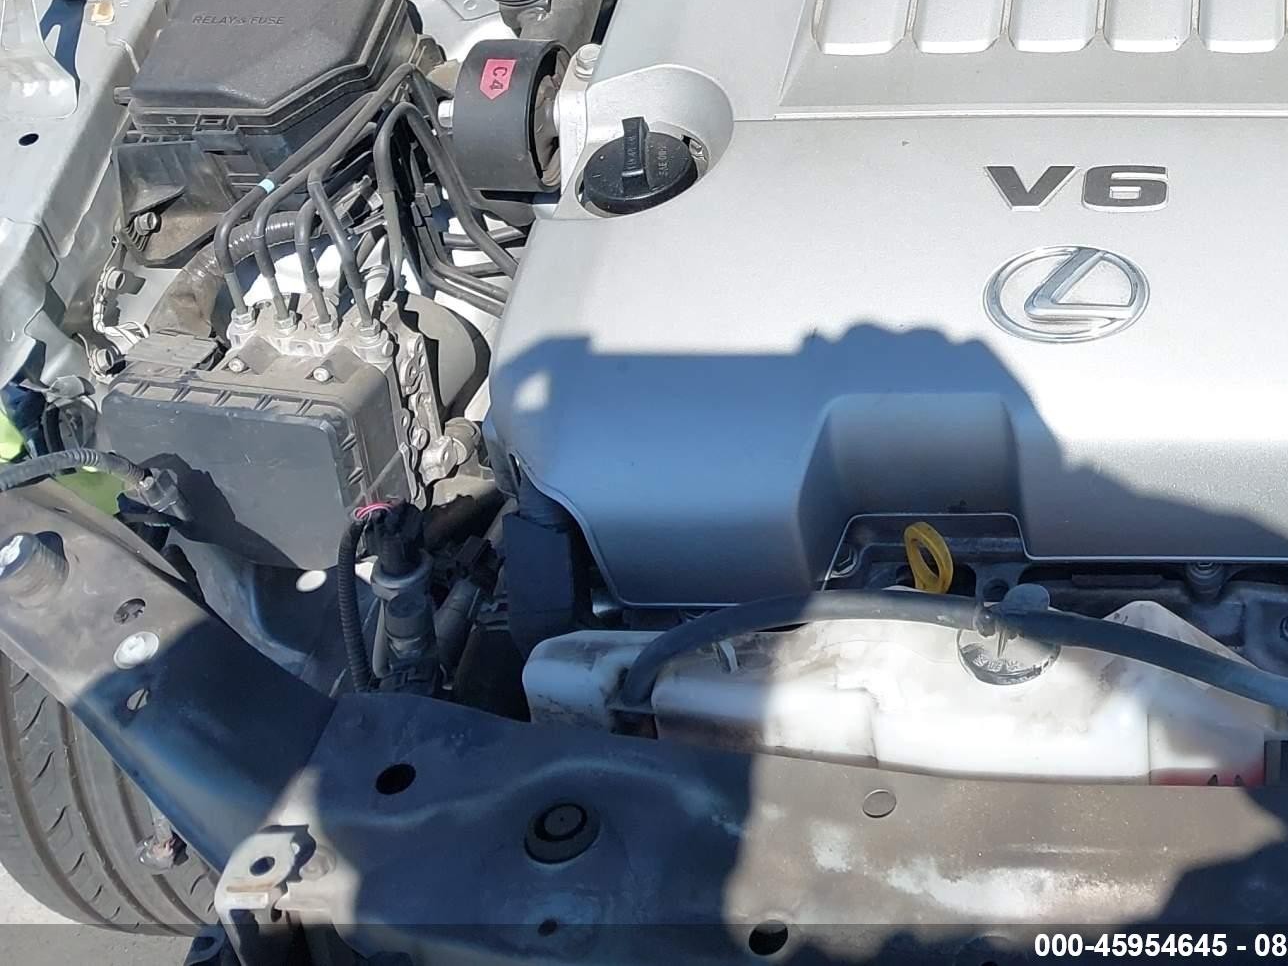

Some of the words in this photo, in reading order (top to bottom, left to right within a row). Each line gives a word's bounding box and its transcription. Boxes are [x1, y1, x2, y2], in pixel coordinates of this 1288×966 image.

[192, 14, 236, 25] RELAY
[249, 15, 286, 25] FUSE
[489, 66, 508, 91] C4
[984, 165, 1169, 213] V6
